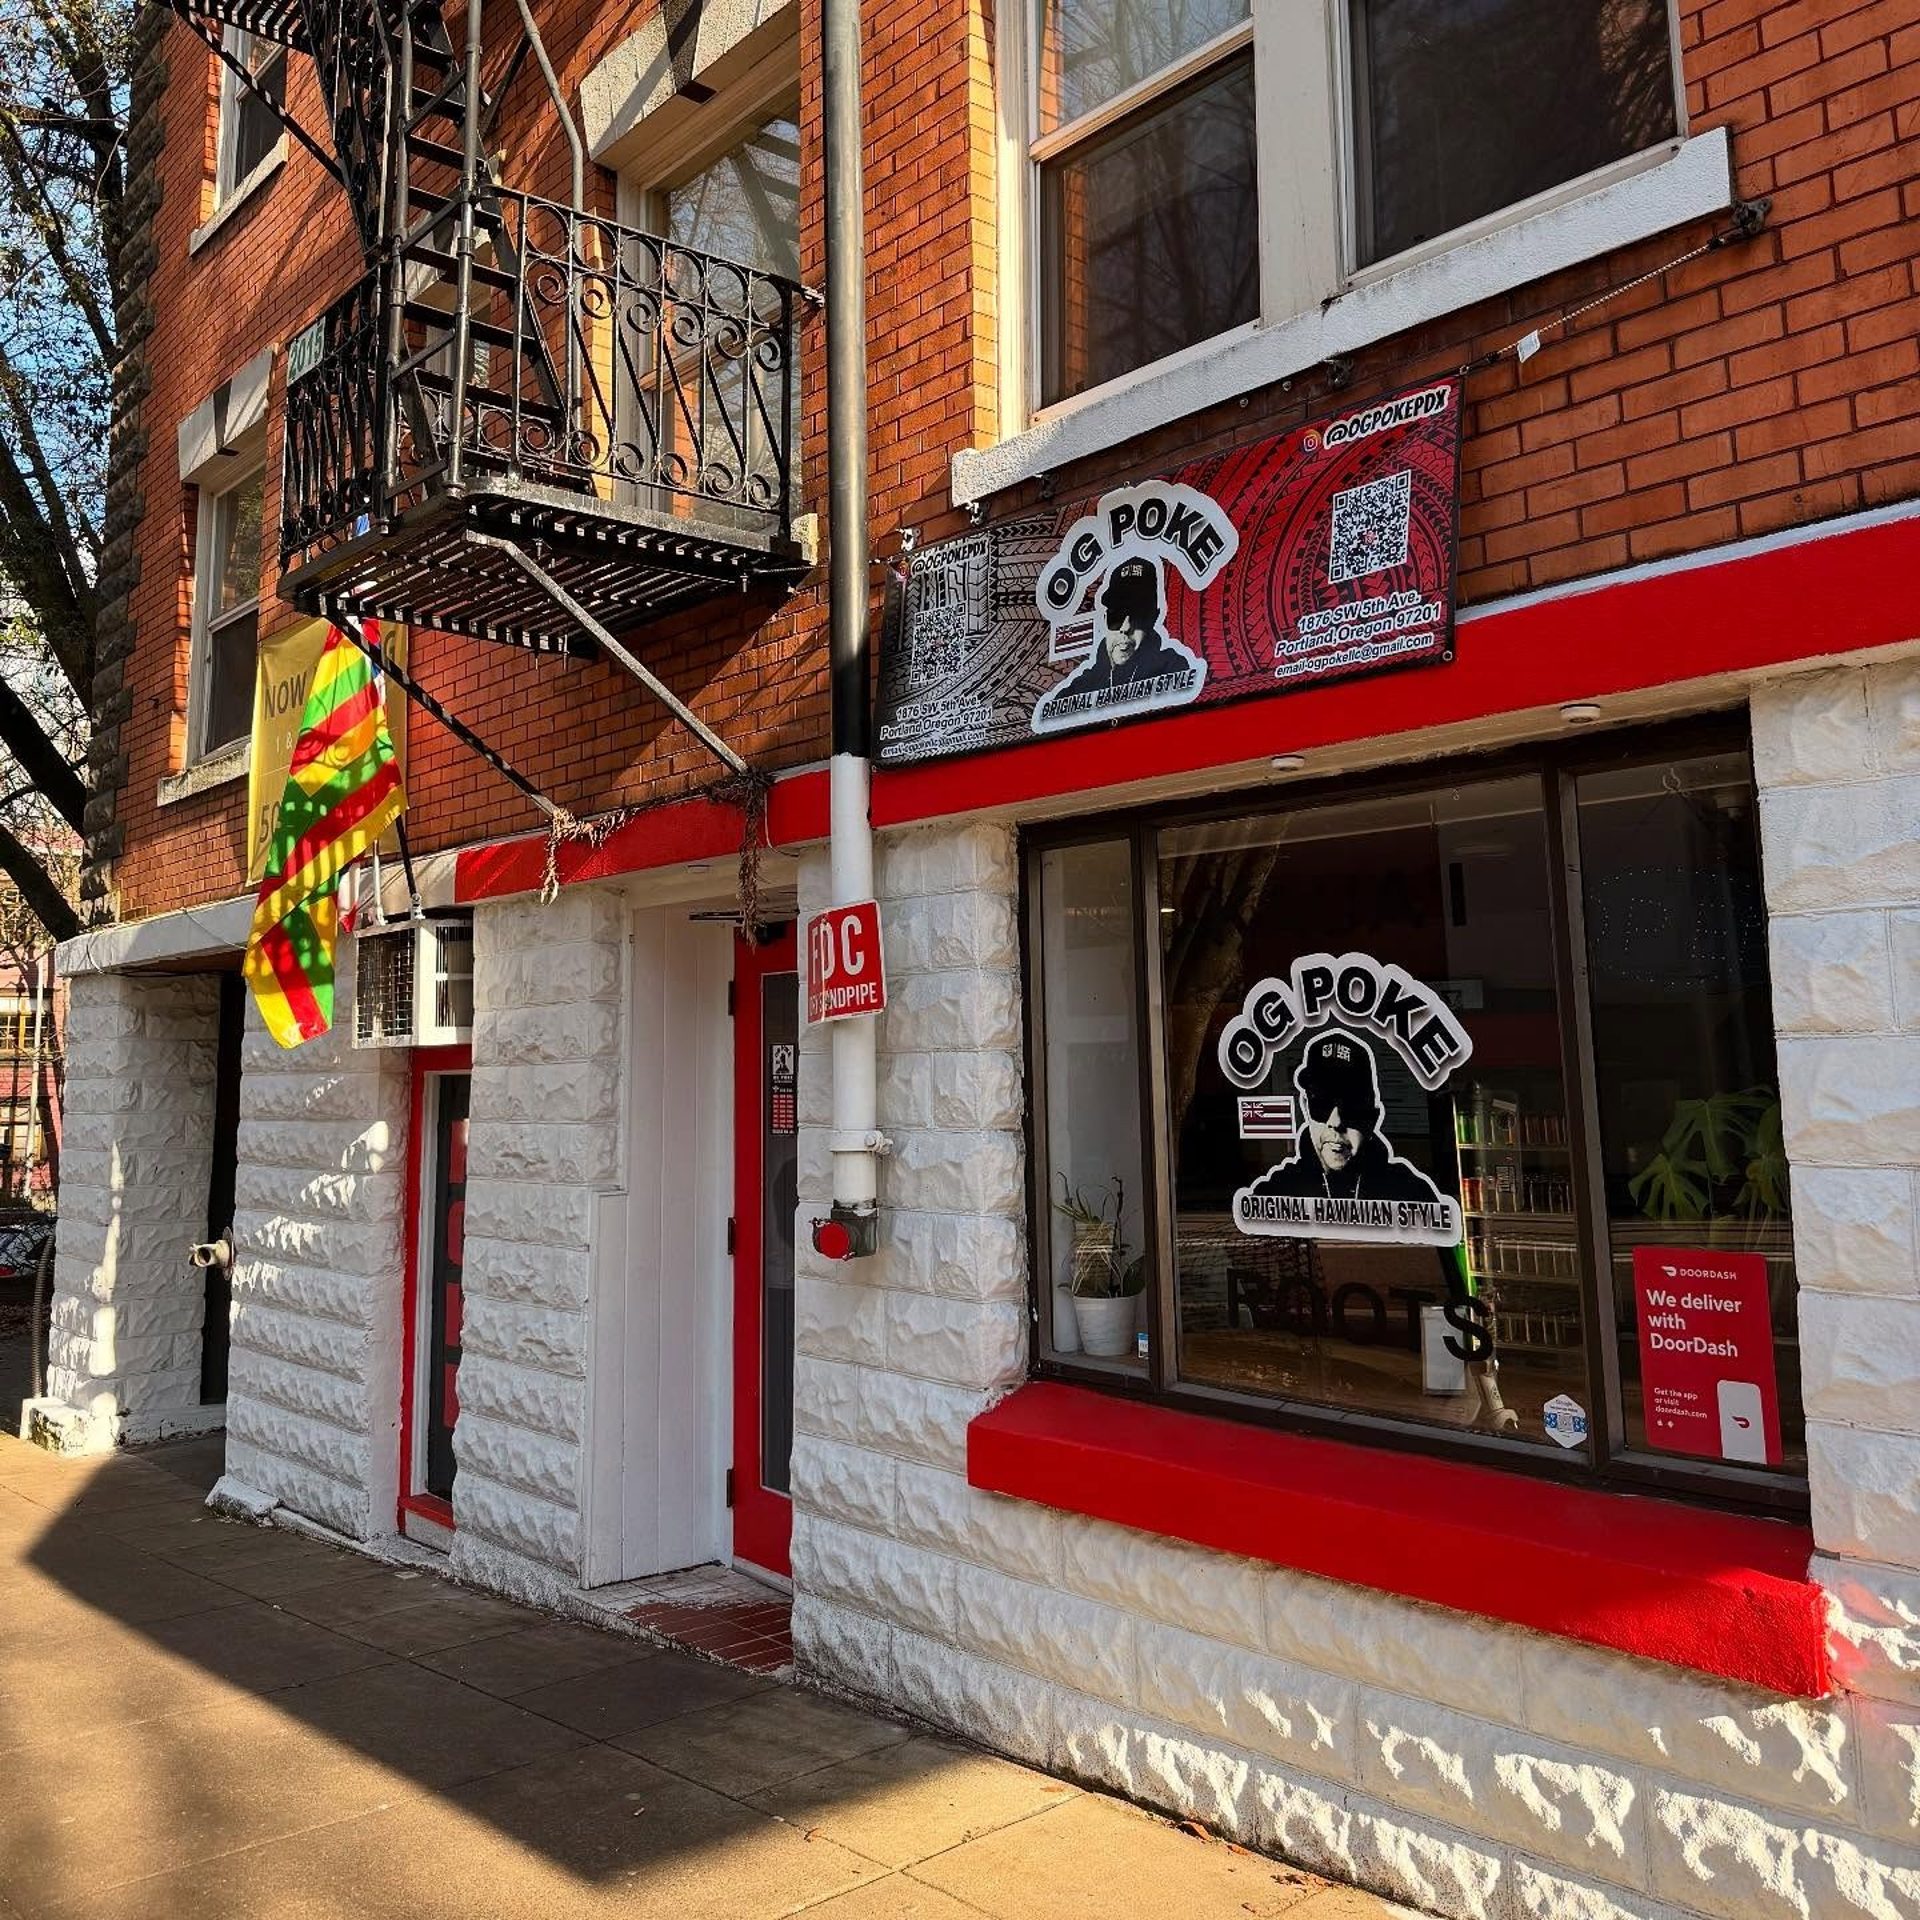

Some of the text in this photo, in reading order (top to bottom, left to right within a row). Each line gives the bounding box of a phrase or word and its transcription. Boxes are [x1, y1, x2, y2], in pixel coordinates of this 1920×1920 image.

[1326, 389, 1447, 445] @OGPOKEPDX
[912, 540, 987, 576] @OGPOKEPDX
[1047, 498, 1225, 608] OG POKE
[1299, 592, 1420, 632] 1876 SW 5th Ave.
[1396, 606, 1440, 627] 97201
[264, 671, 307, 721] NOW
[1042, 669, 1196, 718] ORIGINAL HAWAIIAN STYLE
[898, 706, 919, 720] 1876
[921, 702, 940, 715] SW
[941, 699, 956, 711] 5th
[961, 708, 992, 724] 97201
[1228, 966, 1459, 1078] OG POKE
[1241, 1195, 1451, 1229] ORIGINAL HAWAIIAN STYLE
[1680, 1268, 1737, 1280] DOORDASH
[1647, 1289, 1742, 1312] We deliver
[1648, 1313, 1686, 1330] with
[1651, 1333, 1738, 1357] DoorDash
[1654, 1387, 1698, 1401] Get the app
[1655, 1405, 1708, 1419] doordash.com
